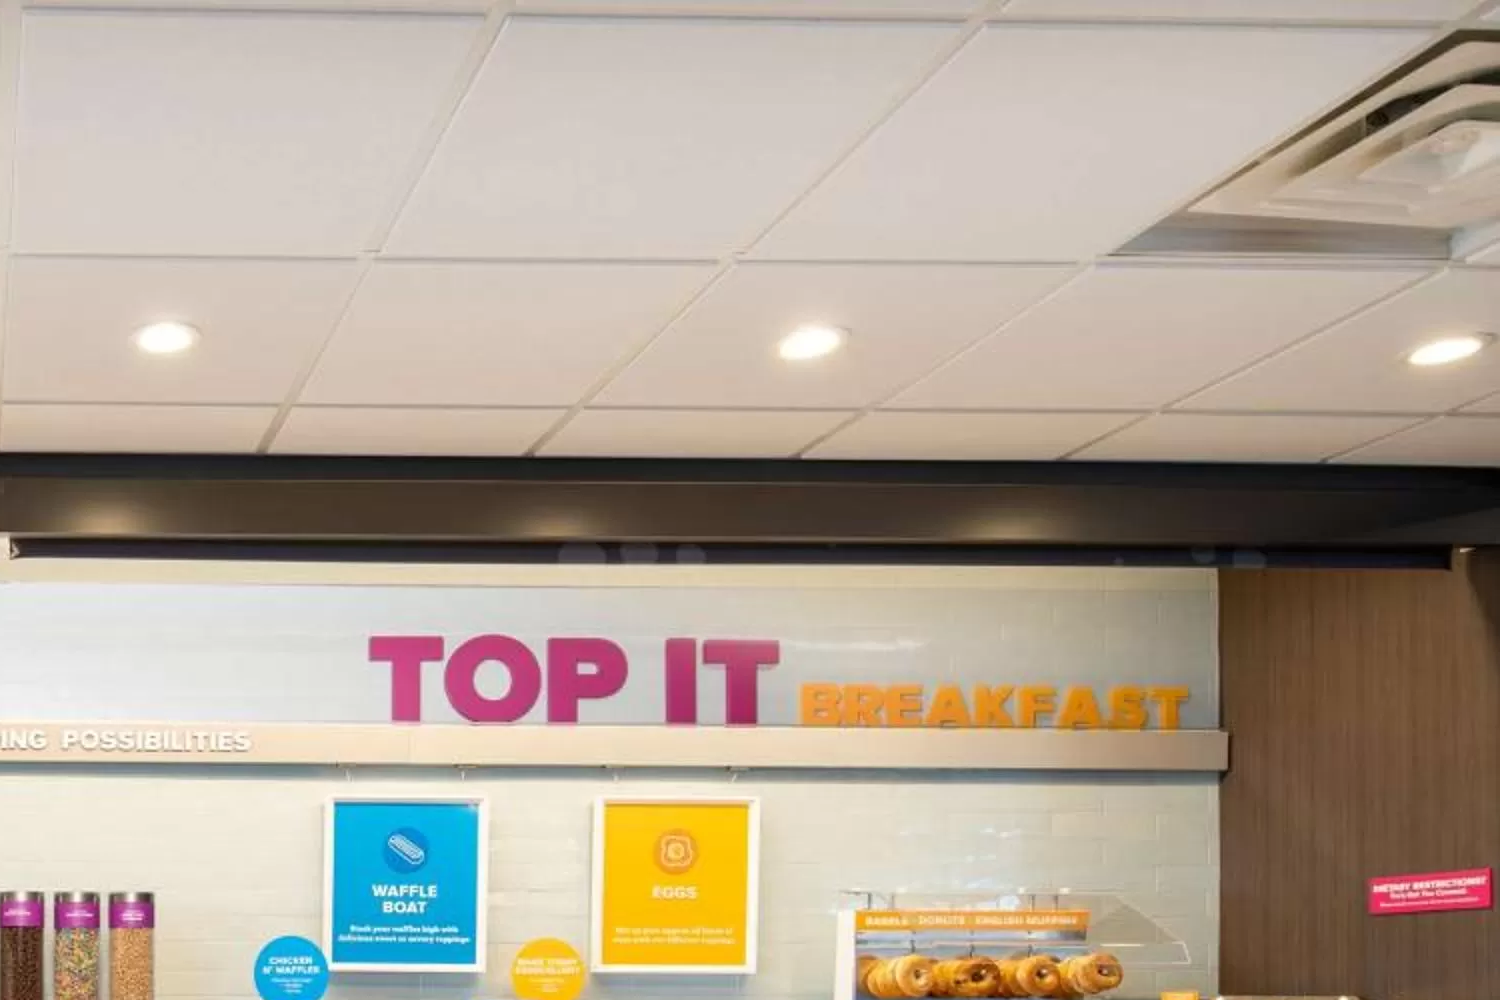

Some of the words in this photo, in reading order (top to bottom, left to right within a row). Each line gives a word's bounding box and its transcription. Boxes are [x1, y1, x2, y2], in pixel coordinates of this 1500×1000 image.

[368, 634, 629, 725] TOP
[665, 637, 780, 726] IT
[799, 681, 1192, 731] BREAKFAST
[61, 730, 252, 753] POSSIBILITIES
[372, 884, 438, 898] WAFFLE
[652, 885, 698, 900] EGGS
[382, 901, 428, 913] BOAT
[268, 955, 313, 965] CHICKEN
[275, 965, 321, 975] WAFFLES
